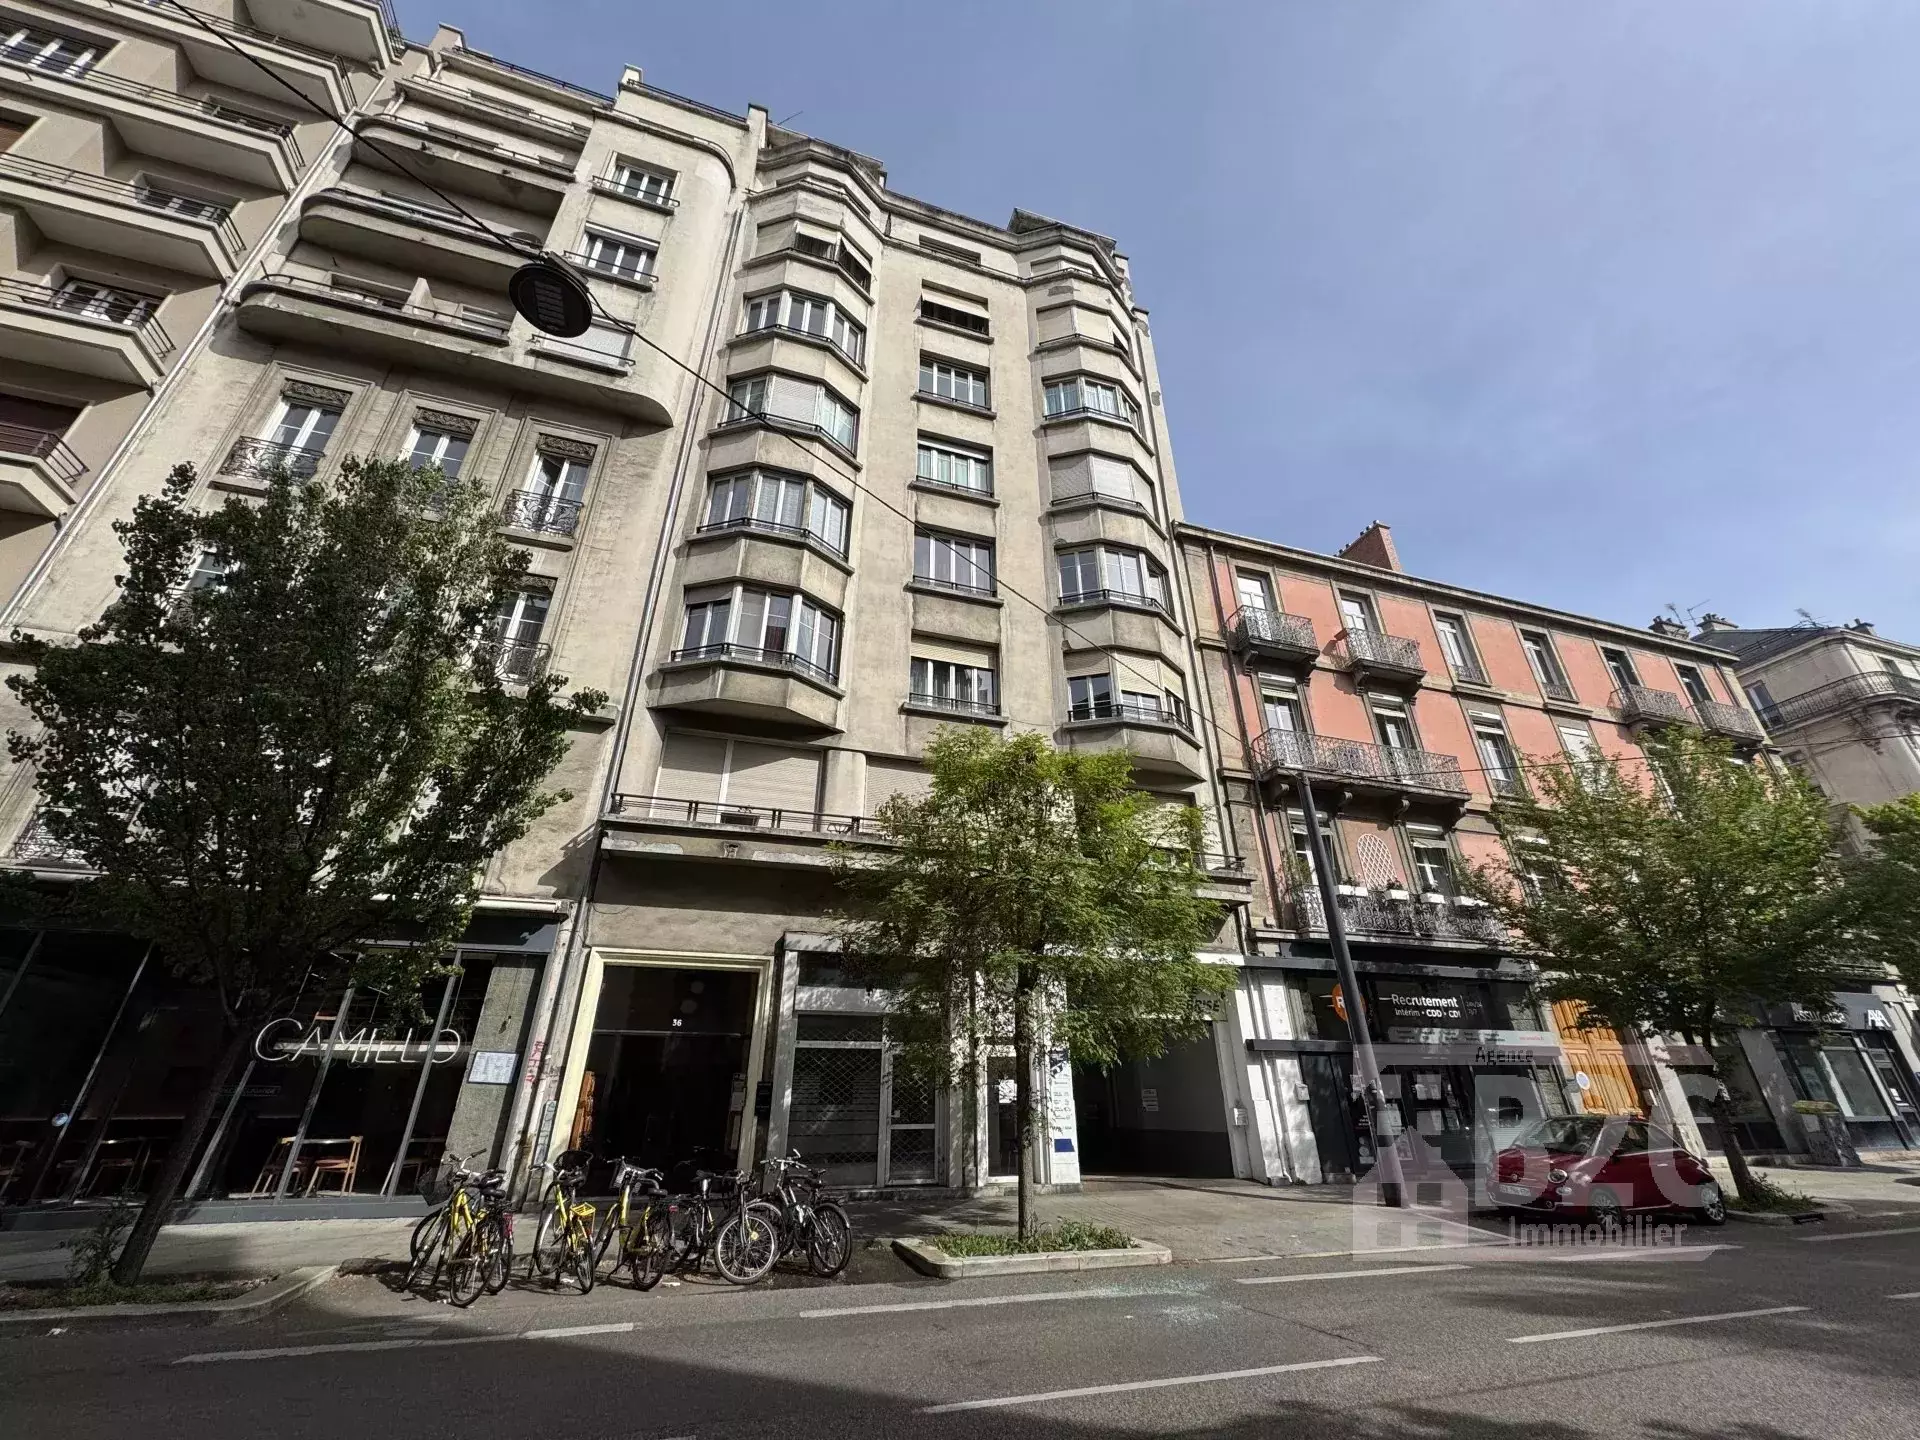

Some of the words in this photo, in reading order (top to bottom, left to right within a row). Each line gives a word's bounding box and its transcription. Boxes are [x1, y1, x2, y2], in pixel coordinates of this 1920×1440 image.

[1391, 993, 1459, 1008] Recrutement
[1395, 1008, 1421, 1017] Intérim
[1426, 1008, 1443, 1018] CDD
[1867, 1009, 1892, 1028] AXA
[672, 1018, 683, 1027] 36
[255, 1017, 461, 1064] CAMILLO
